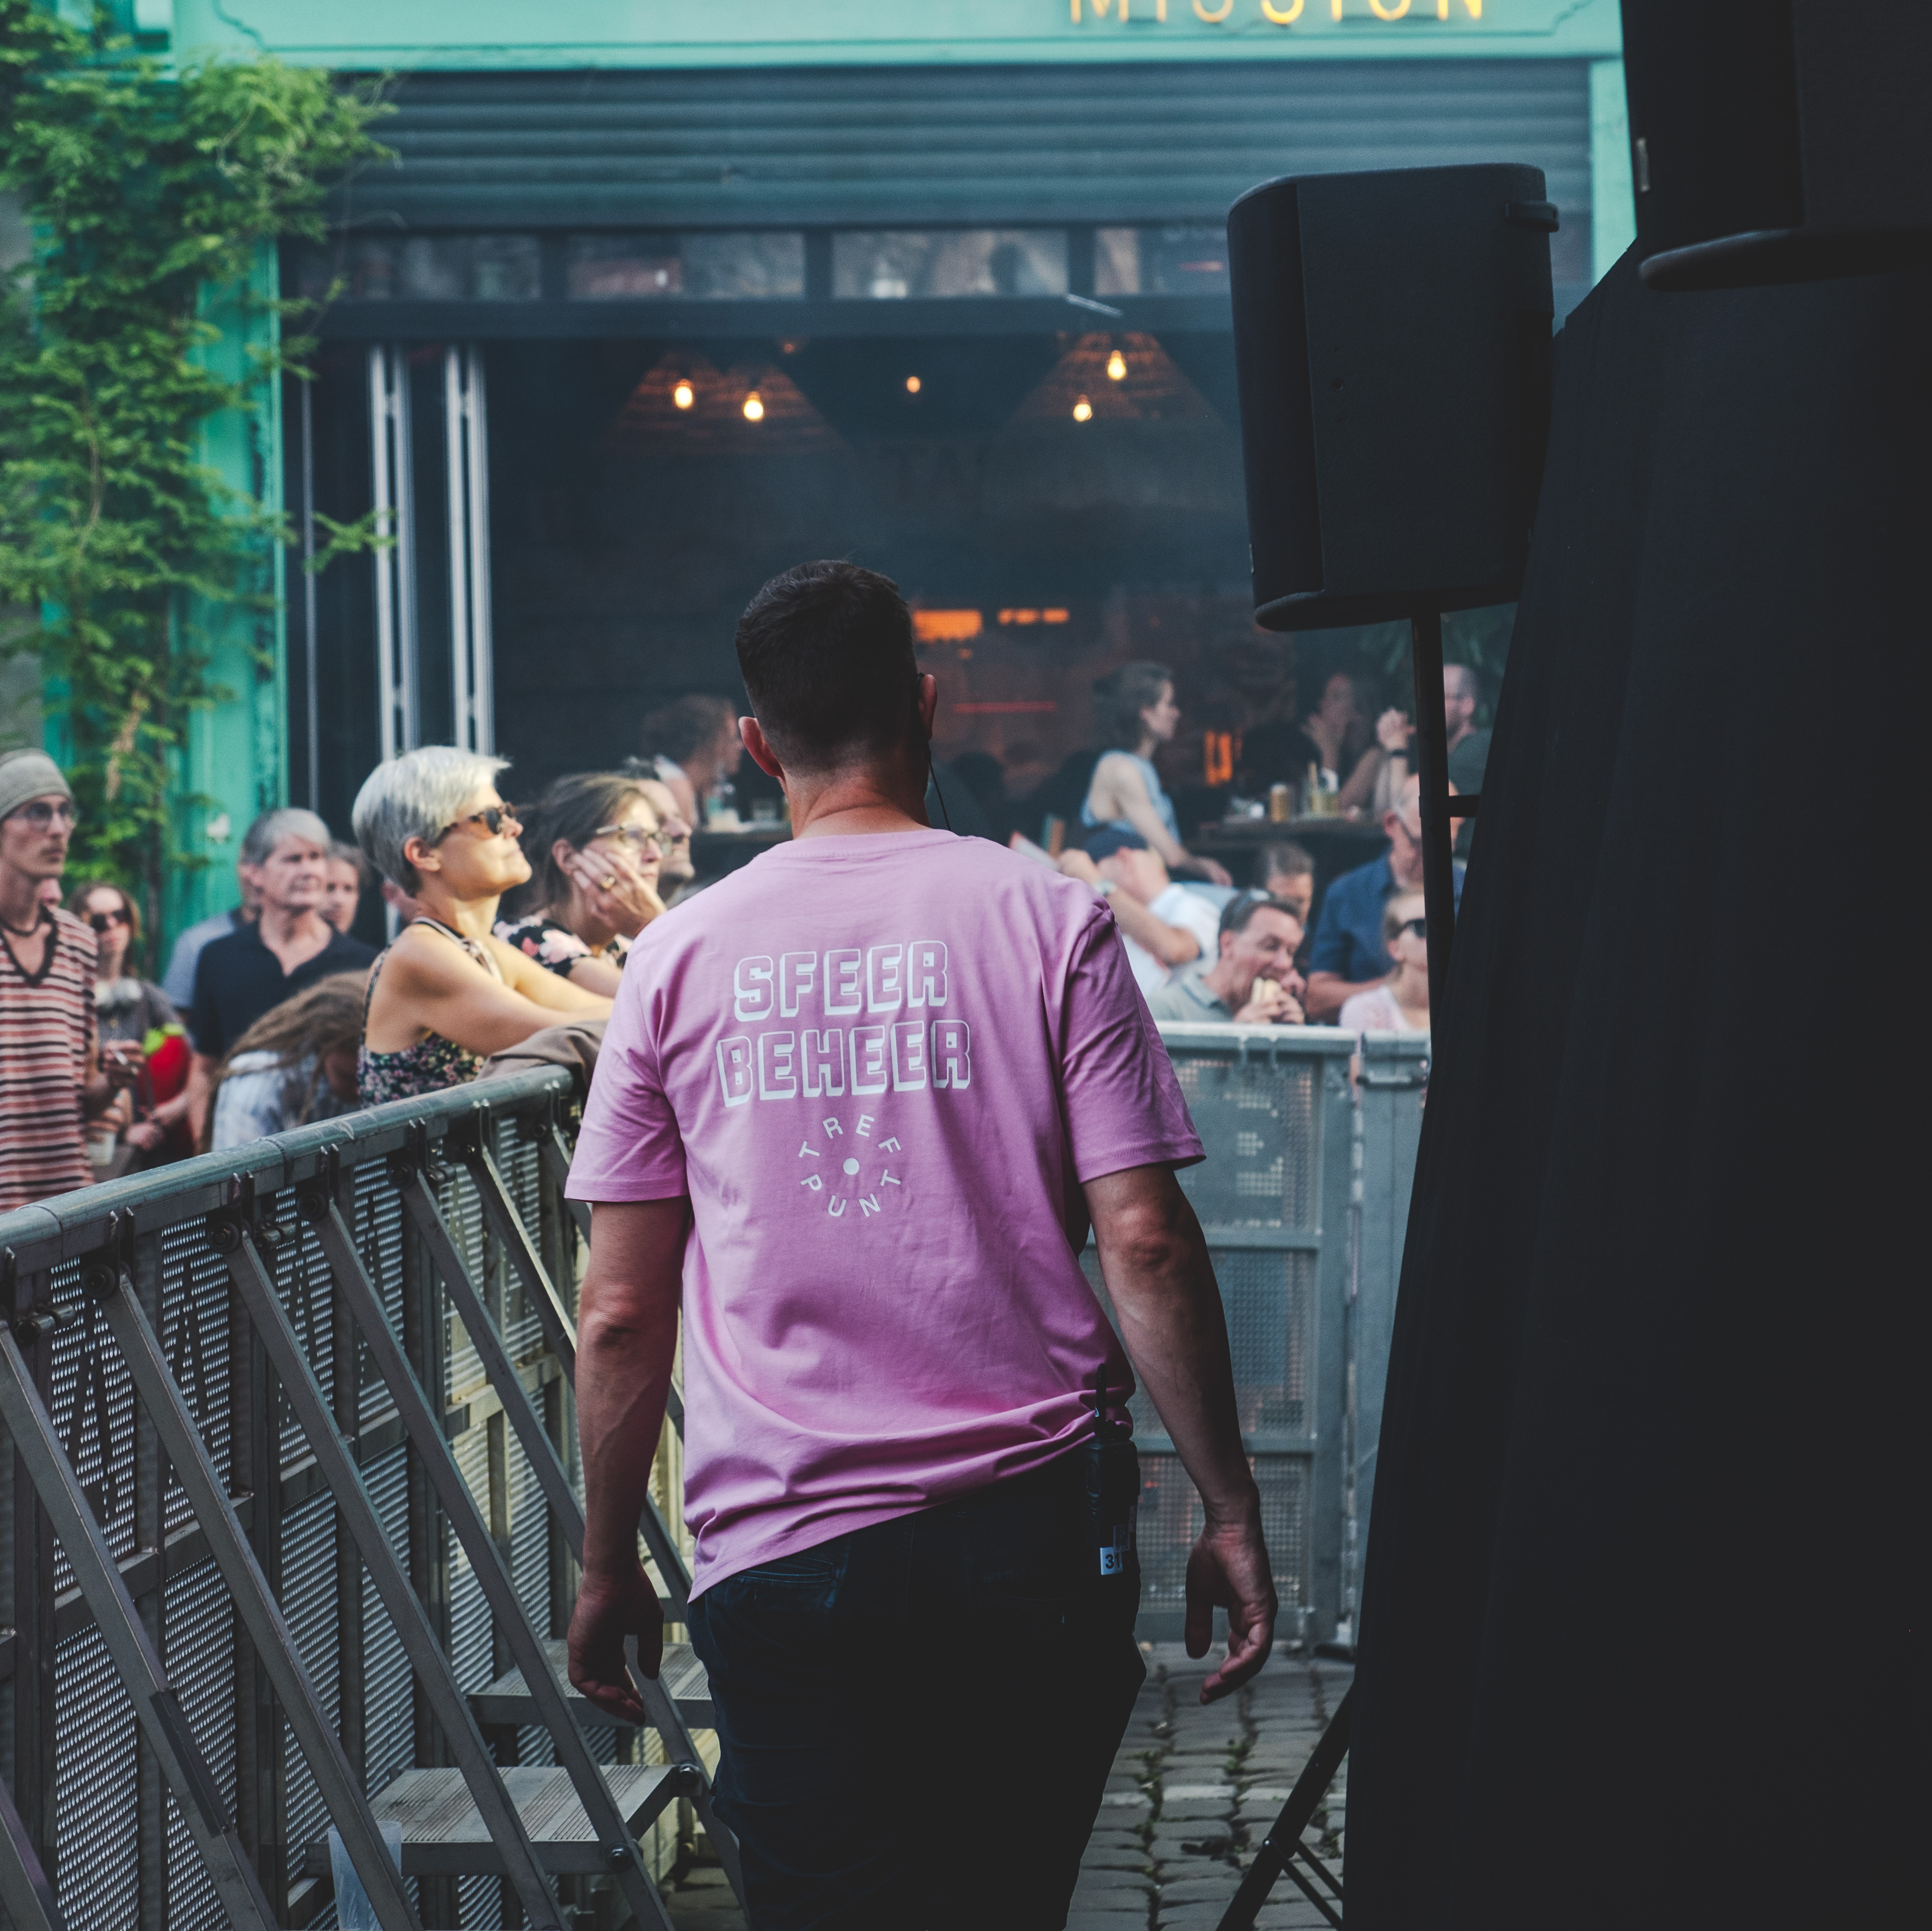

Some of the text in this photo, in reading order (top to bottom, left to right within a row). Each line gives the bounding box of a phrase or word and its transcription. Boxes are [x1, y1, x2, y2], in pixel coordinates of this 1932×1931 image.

[733, 940, 948, 1022] SFEER
[716, 1019, 970, 1108] BEHEER
[798, 1114, 901, 1157] TREF
[800, 1168, 901, 1217] PUNT
[1105, 1552, 1120, 1569] 31
